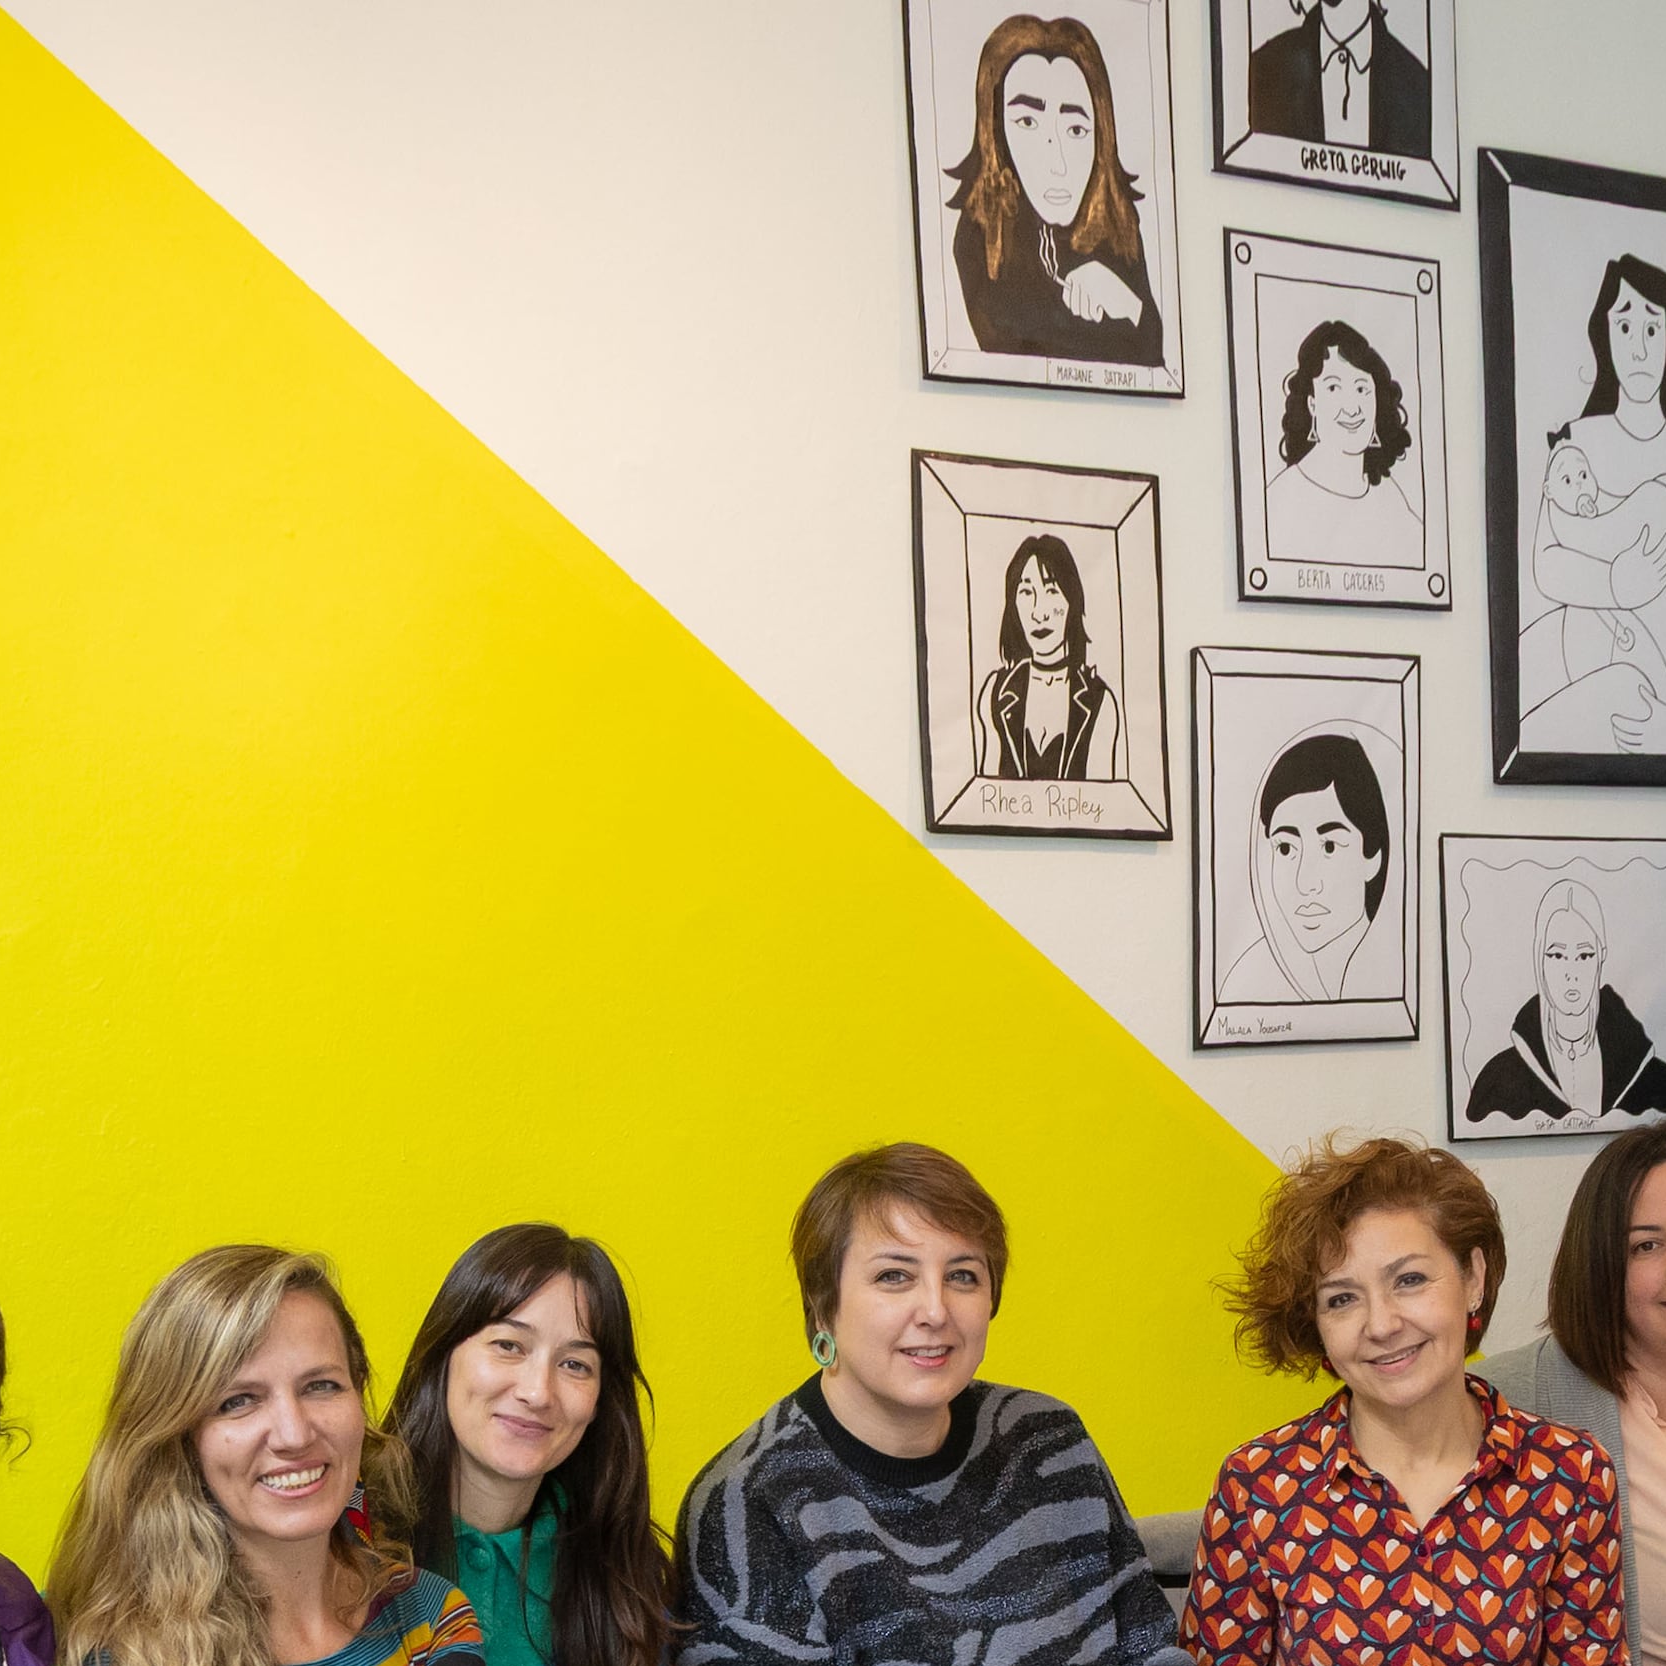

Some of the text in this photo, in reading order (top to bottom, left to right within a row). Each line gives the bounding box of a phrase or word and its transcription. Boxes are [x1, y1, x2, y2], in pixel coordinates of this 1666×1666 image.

[1057, 366, 1137, 388] MARJANE SATRAPI
[1297, 568, 1331, 590] BERTA
[980, 784, 1104, 824] Rhea Ripley
